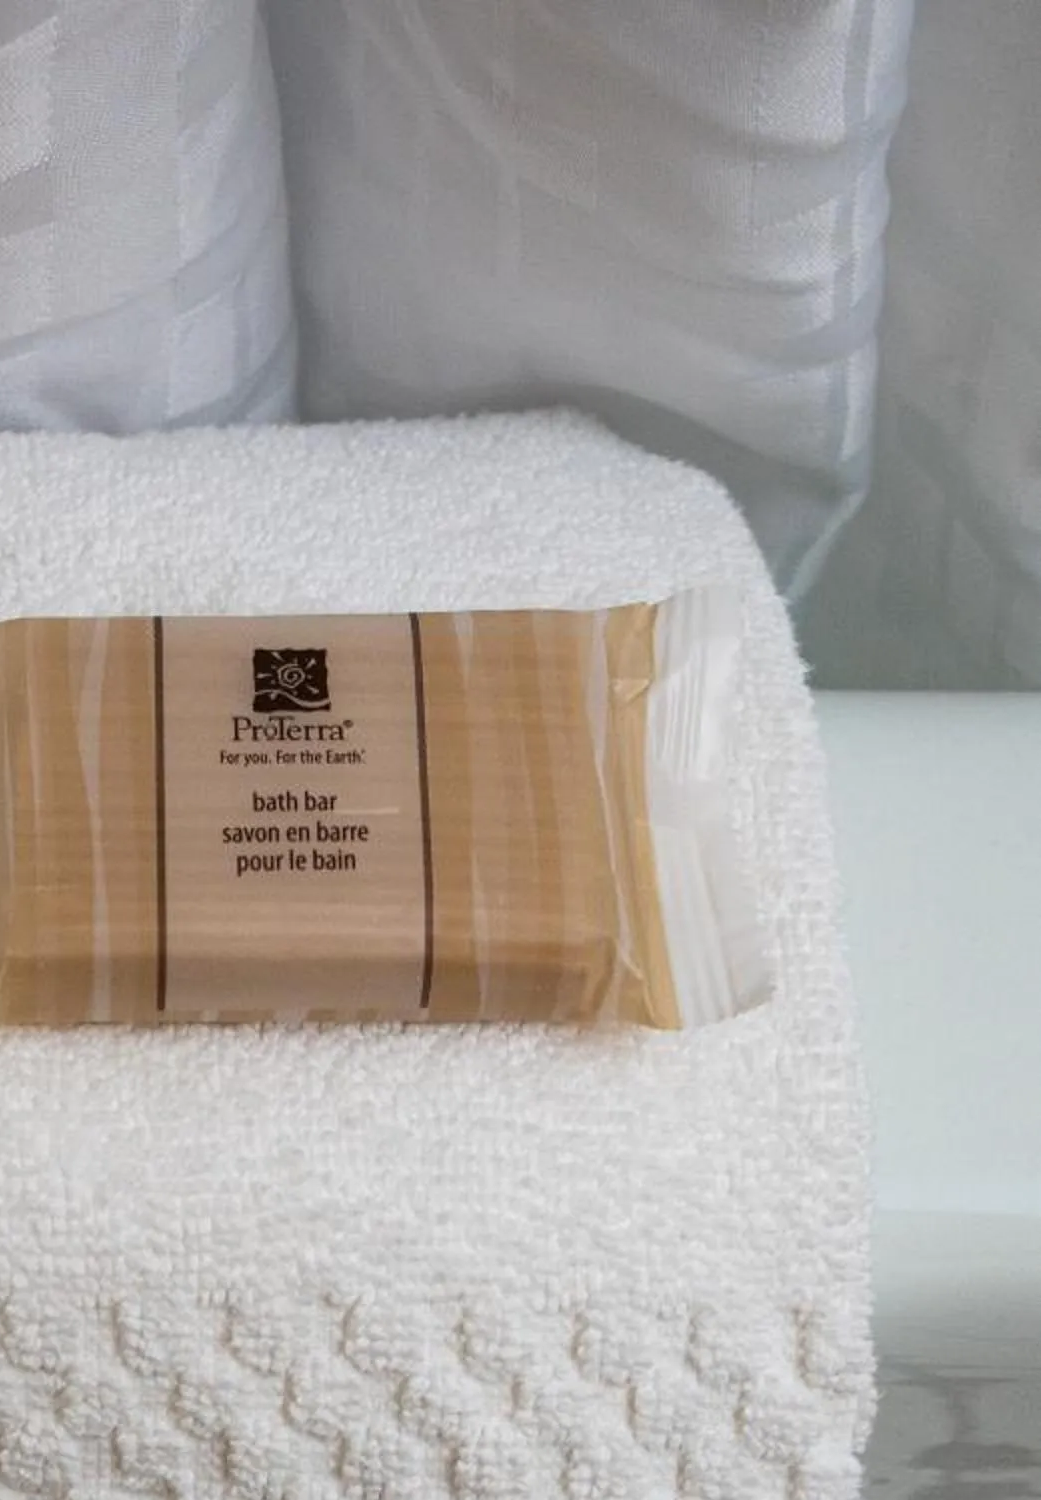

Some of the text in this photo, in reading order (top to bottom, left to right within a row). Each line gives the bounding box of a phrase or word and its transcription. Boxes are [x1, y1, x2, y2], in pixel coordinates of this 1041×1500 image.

[219, 750, 241, 764] For
[243, 752, 272, 767] you.
[276, 750, 297, 764] For
[300, 750, 322, 764] the
[252, 790, 338, 813] bath bar
[221, 820, 370, 844] savon en barre
[236, 849, 357, 877] pour le bain
